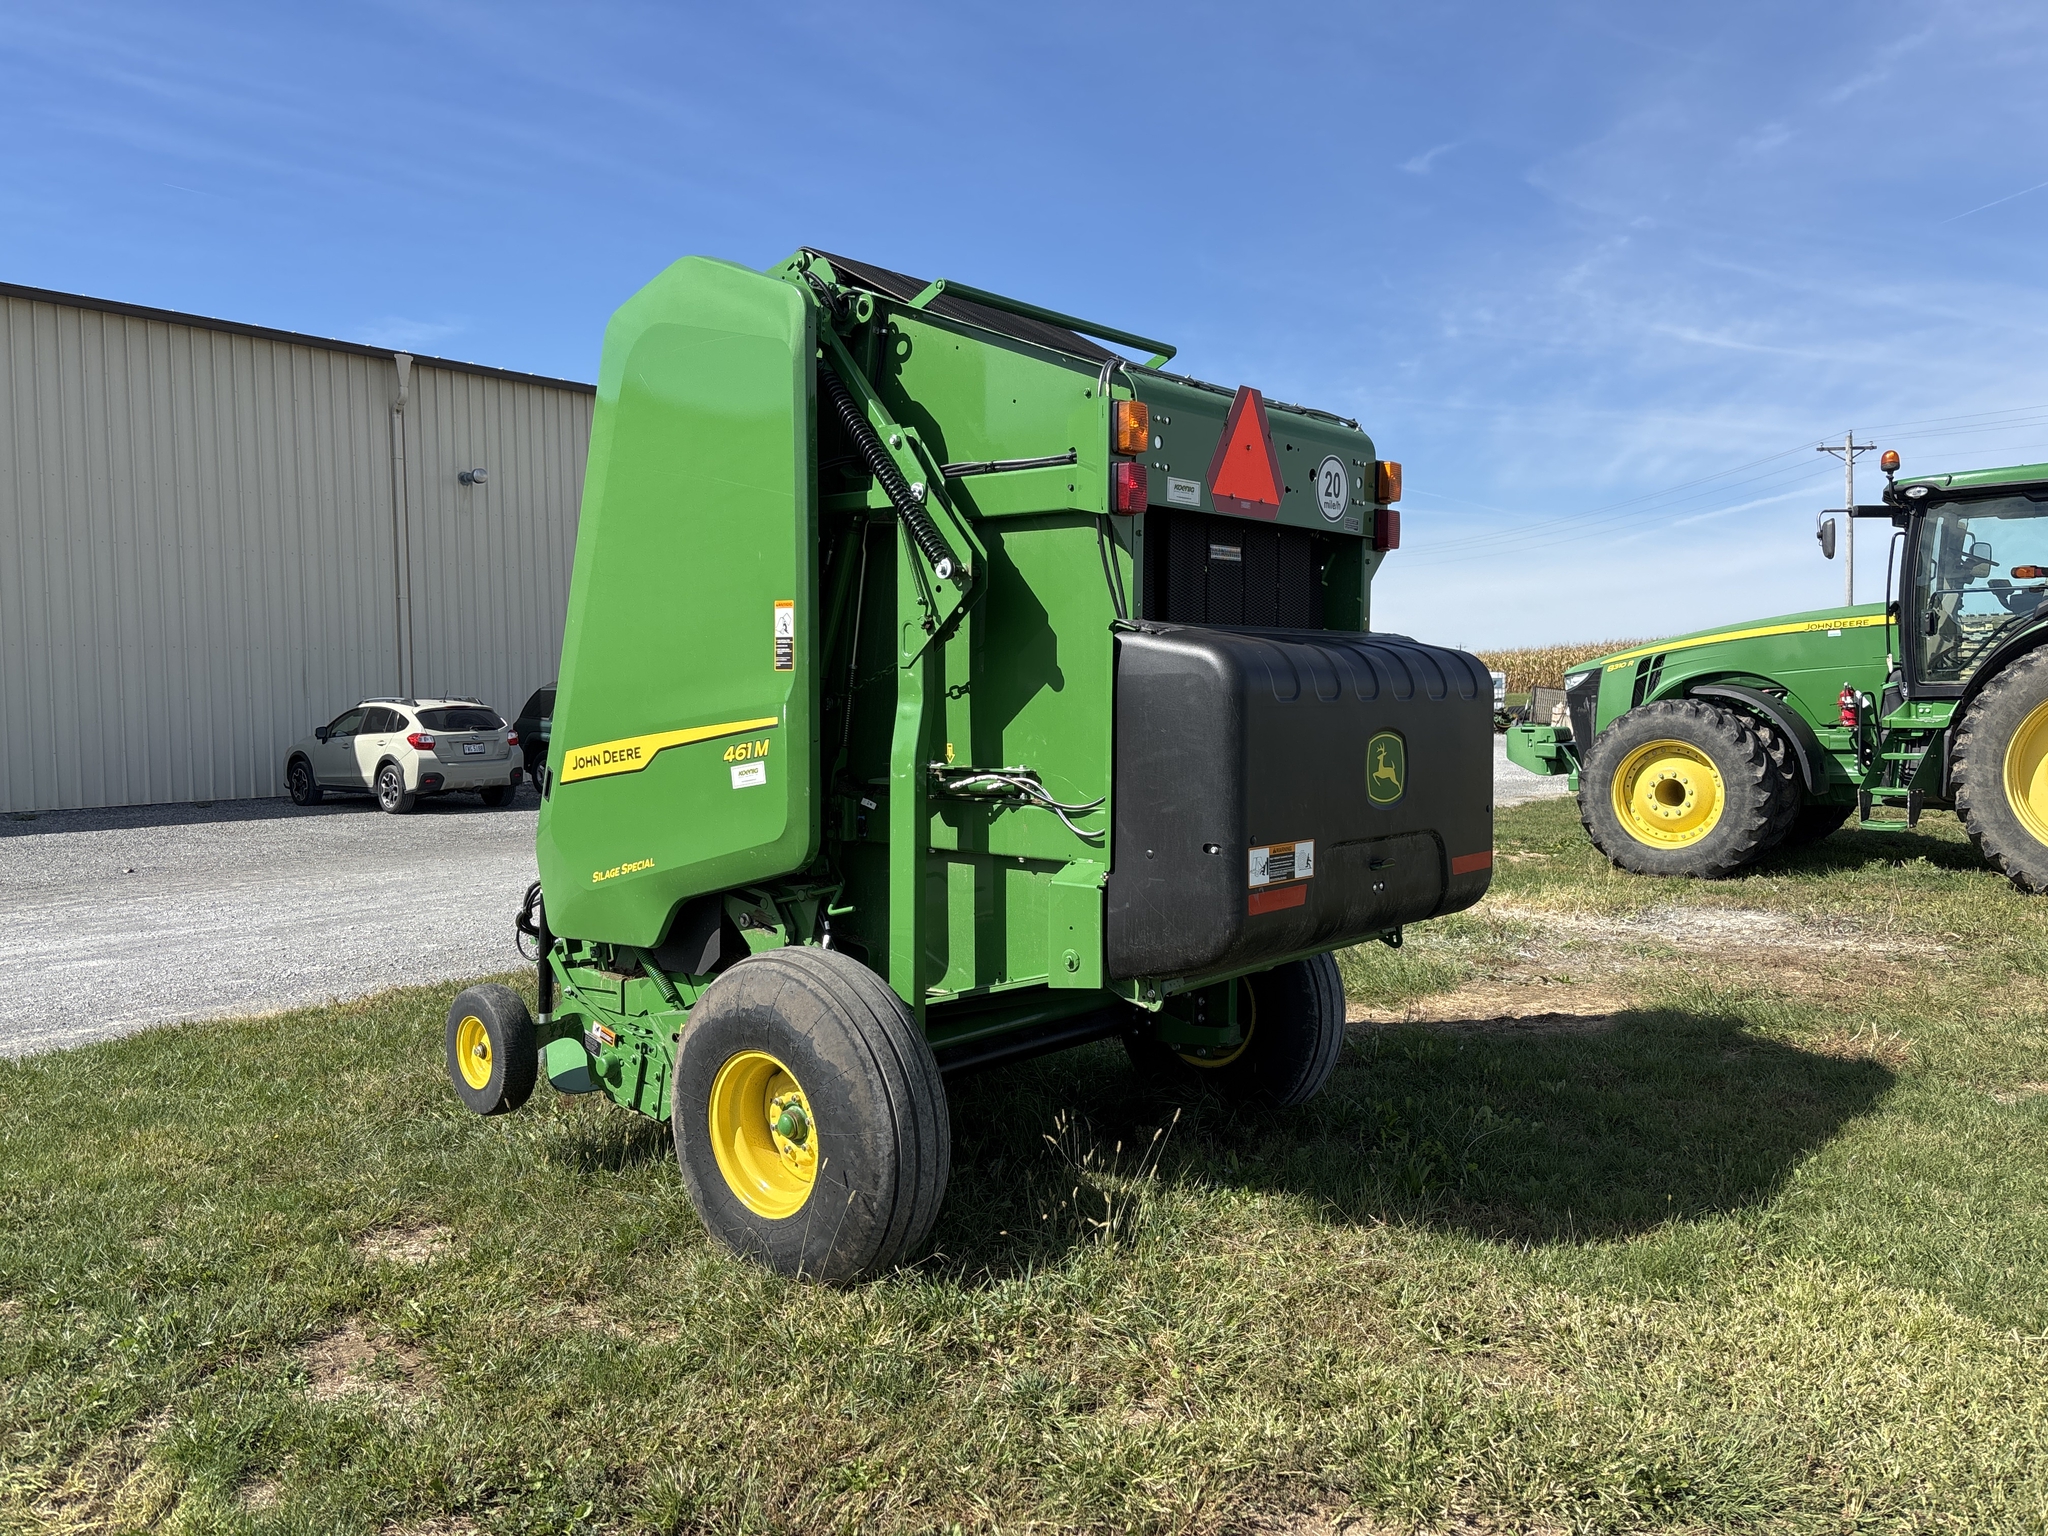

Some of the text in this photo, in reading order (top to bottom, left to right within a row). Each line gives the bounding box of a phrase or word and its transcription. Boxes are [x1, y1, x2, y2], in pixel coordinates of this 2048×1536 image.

[1324, 470, 1341, 499] 20
[1323, 500, 1341, 510] mile/h
[1804, 619, 1870, 631] JOHN DEERE
[1606, 659, 1635, 673] 8310 R
[572, 746, 642, 771] JOHN DEERE
[723, 738, 770, 763] 461 M
[592, 857, 655, 883] SILAGE SPECIAL
